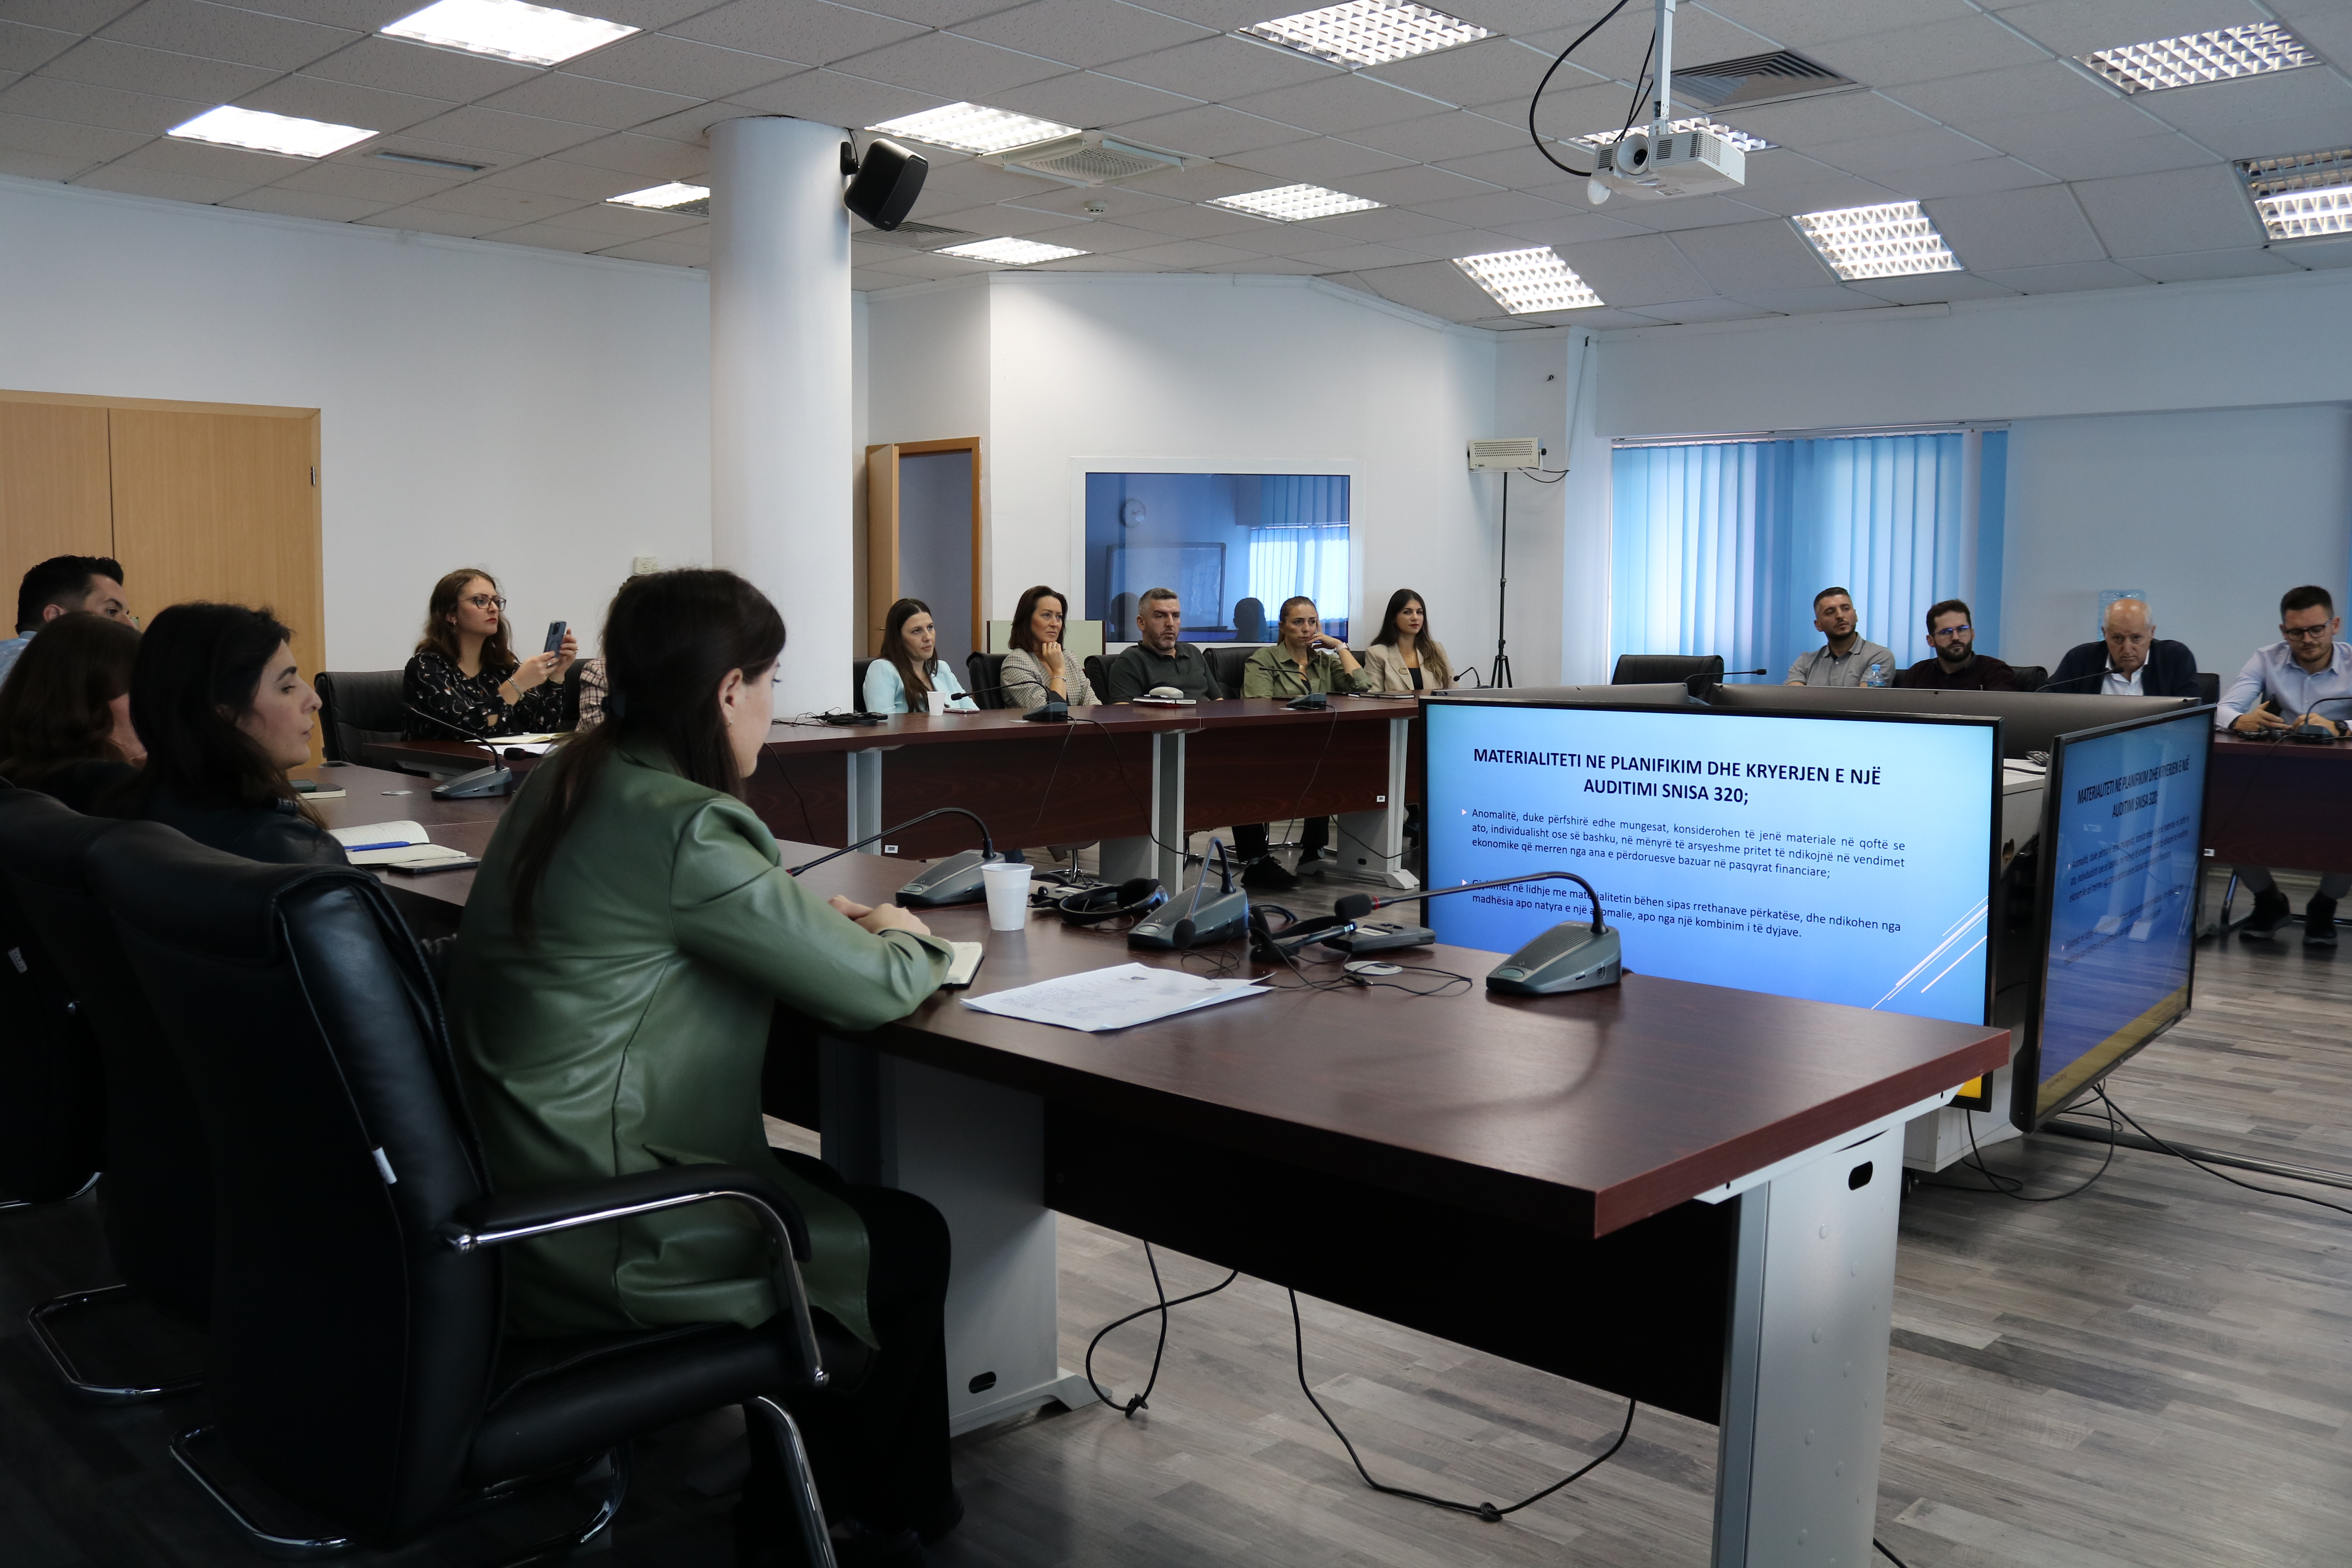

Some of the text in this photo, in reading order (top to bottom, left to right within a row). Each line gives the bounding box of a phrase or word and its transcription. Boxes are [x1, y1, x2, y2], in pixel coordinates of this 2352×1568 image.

[1474, 748, 1881, 786] MATERIALITETI NE PLANIFIKIM DHE KRYERJEN E NJË
[1583, 779, 1749, 806] AUDITIMI SNISA 320;
[2077, 780, 2114, 805] MATERIALITETI
[1472, 808, 1906, 851] Anomalitë, duke përfshirë edhe mungesat, konsiderohen të jenë materiale në qoftë se
[1472, 823, 1905, 867] ato, individualisht ose së bashku, në mënyrë të arsyeshme pritet të ndikojnë në vendimet
[1472, 837, 1519, 850] ekonomike
[1521, 842, 1533, 853] që
[1534, 844, 1568, 855] merren
[1570, 847, 1586, 858] nga
[1588, 849, 1606, 858] ana
[1616, 850, 1676, 864] përdoruesve
[1678, 854, 1712, 867] bazuar
[1713, 858, 1727, 869] në
[1729, 861, 1773, 873] pasqyrat
[1775, 863, 1830, 880] financiare;
[1472, 894, 1514, 907] madhësia
[1515, 900, 1533, 910] apo
[1534, 901, 1563, 913] natyra
[1573, 904, 1588, 916] një
[1590, 907, 1635, 922] aomalie,
[1637, 913, 1656, 923] apo
[1658, 915, 1675, 926] nga
[1677, 915, 1693, 927] një
[1695, 916, 1744, 931] kombinim
[1747, 922, 1750, 932] i
[1752, 923, 1763, 933] të
[1766, 924, 1802, 938] dyjave.
[1512, 883, 1524, 894] në
[1526, 883, 1551, 899] lidhje
[1552, 889, 1568, 898] me
[1569, 888, 1632, 904] mateialitetin
[1634, 895, 1664, 907] bëhen
[1666, 898, 1691, 911] sipas
[1693, 902, 1747, 916] rrethanave
[1749, 907, 1803, 924] përkatëse,
[1806, 912, 1826, 924] dhe
[1829, 915, 1878, 929] ndikohen
[1882, 922, 1901, 933] nga
